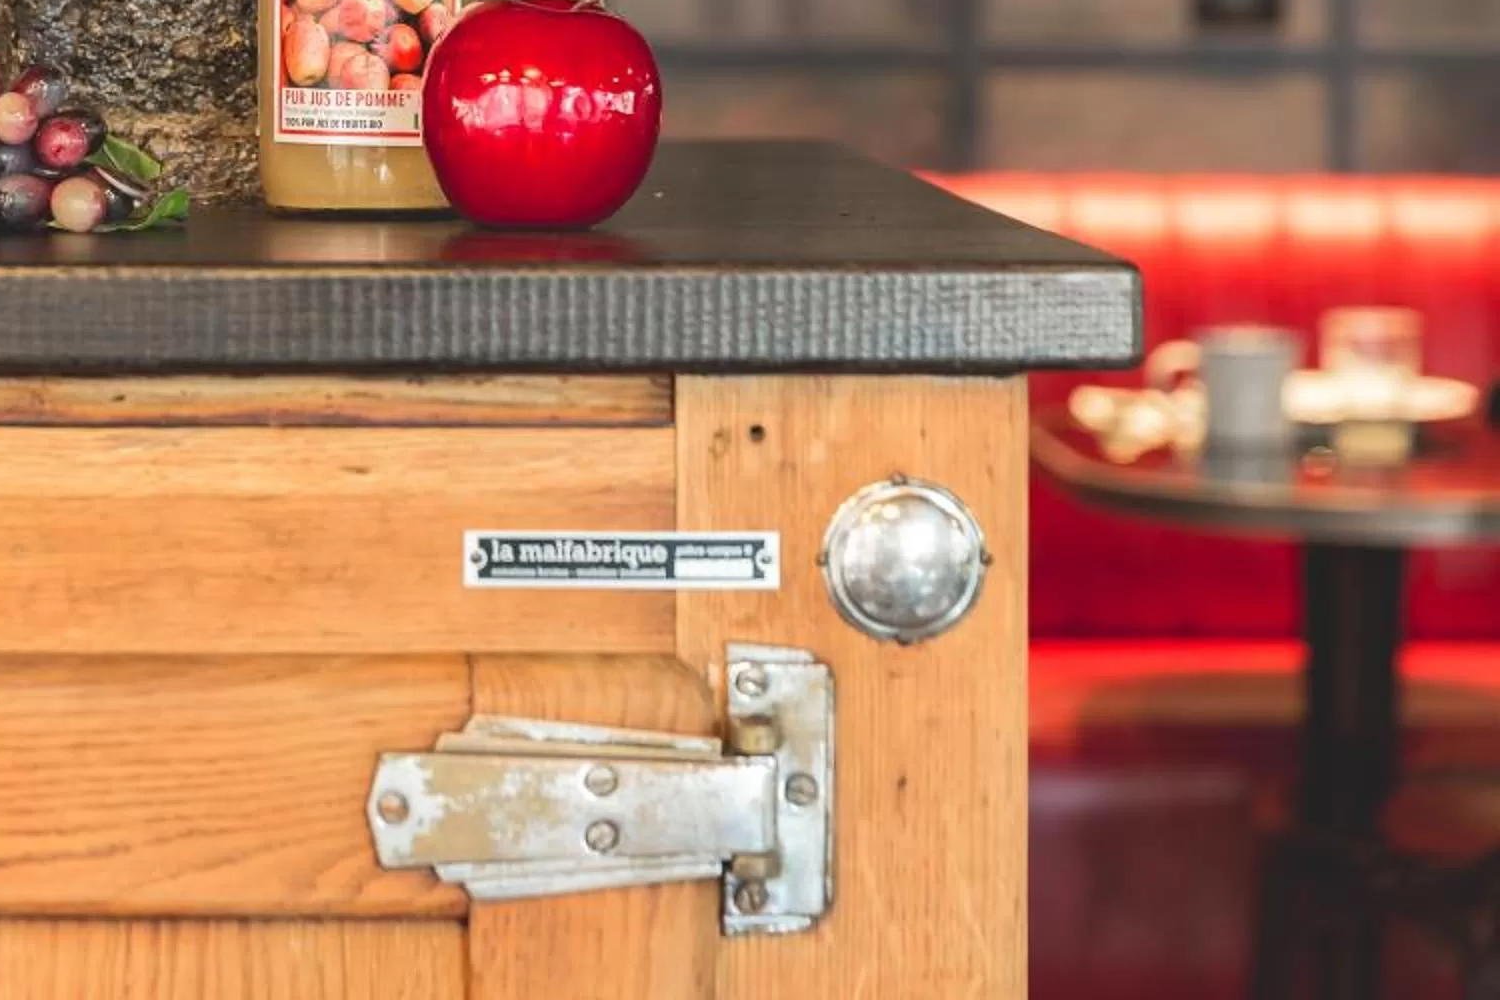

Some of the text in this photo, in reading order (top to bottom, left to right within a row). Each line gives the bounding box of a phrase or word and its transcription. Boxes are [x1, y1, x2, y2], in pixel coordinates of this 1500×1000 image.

[285, 90, 305, 105] PUR
[311, 91, 332, 107] JUS
[335, 92, 353, 107] DE
[490, 538, 515, 563] la
